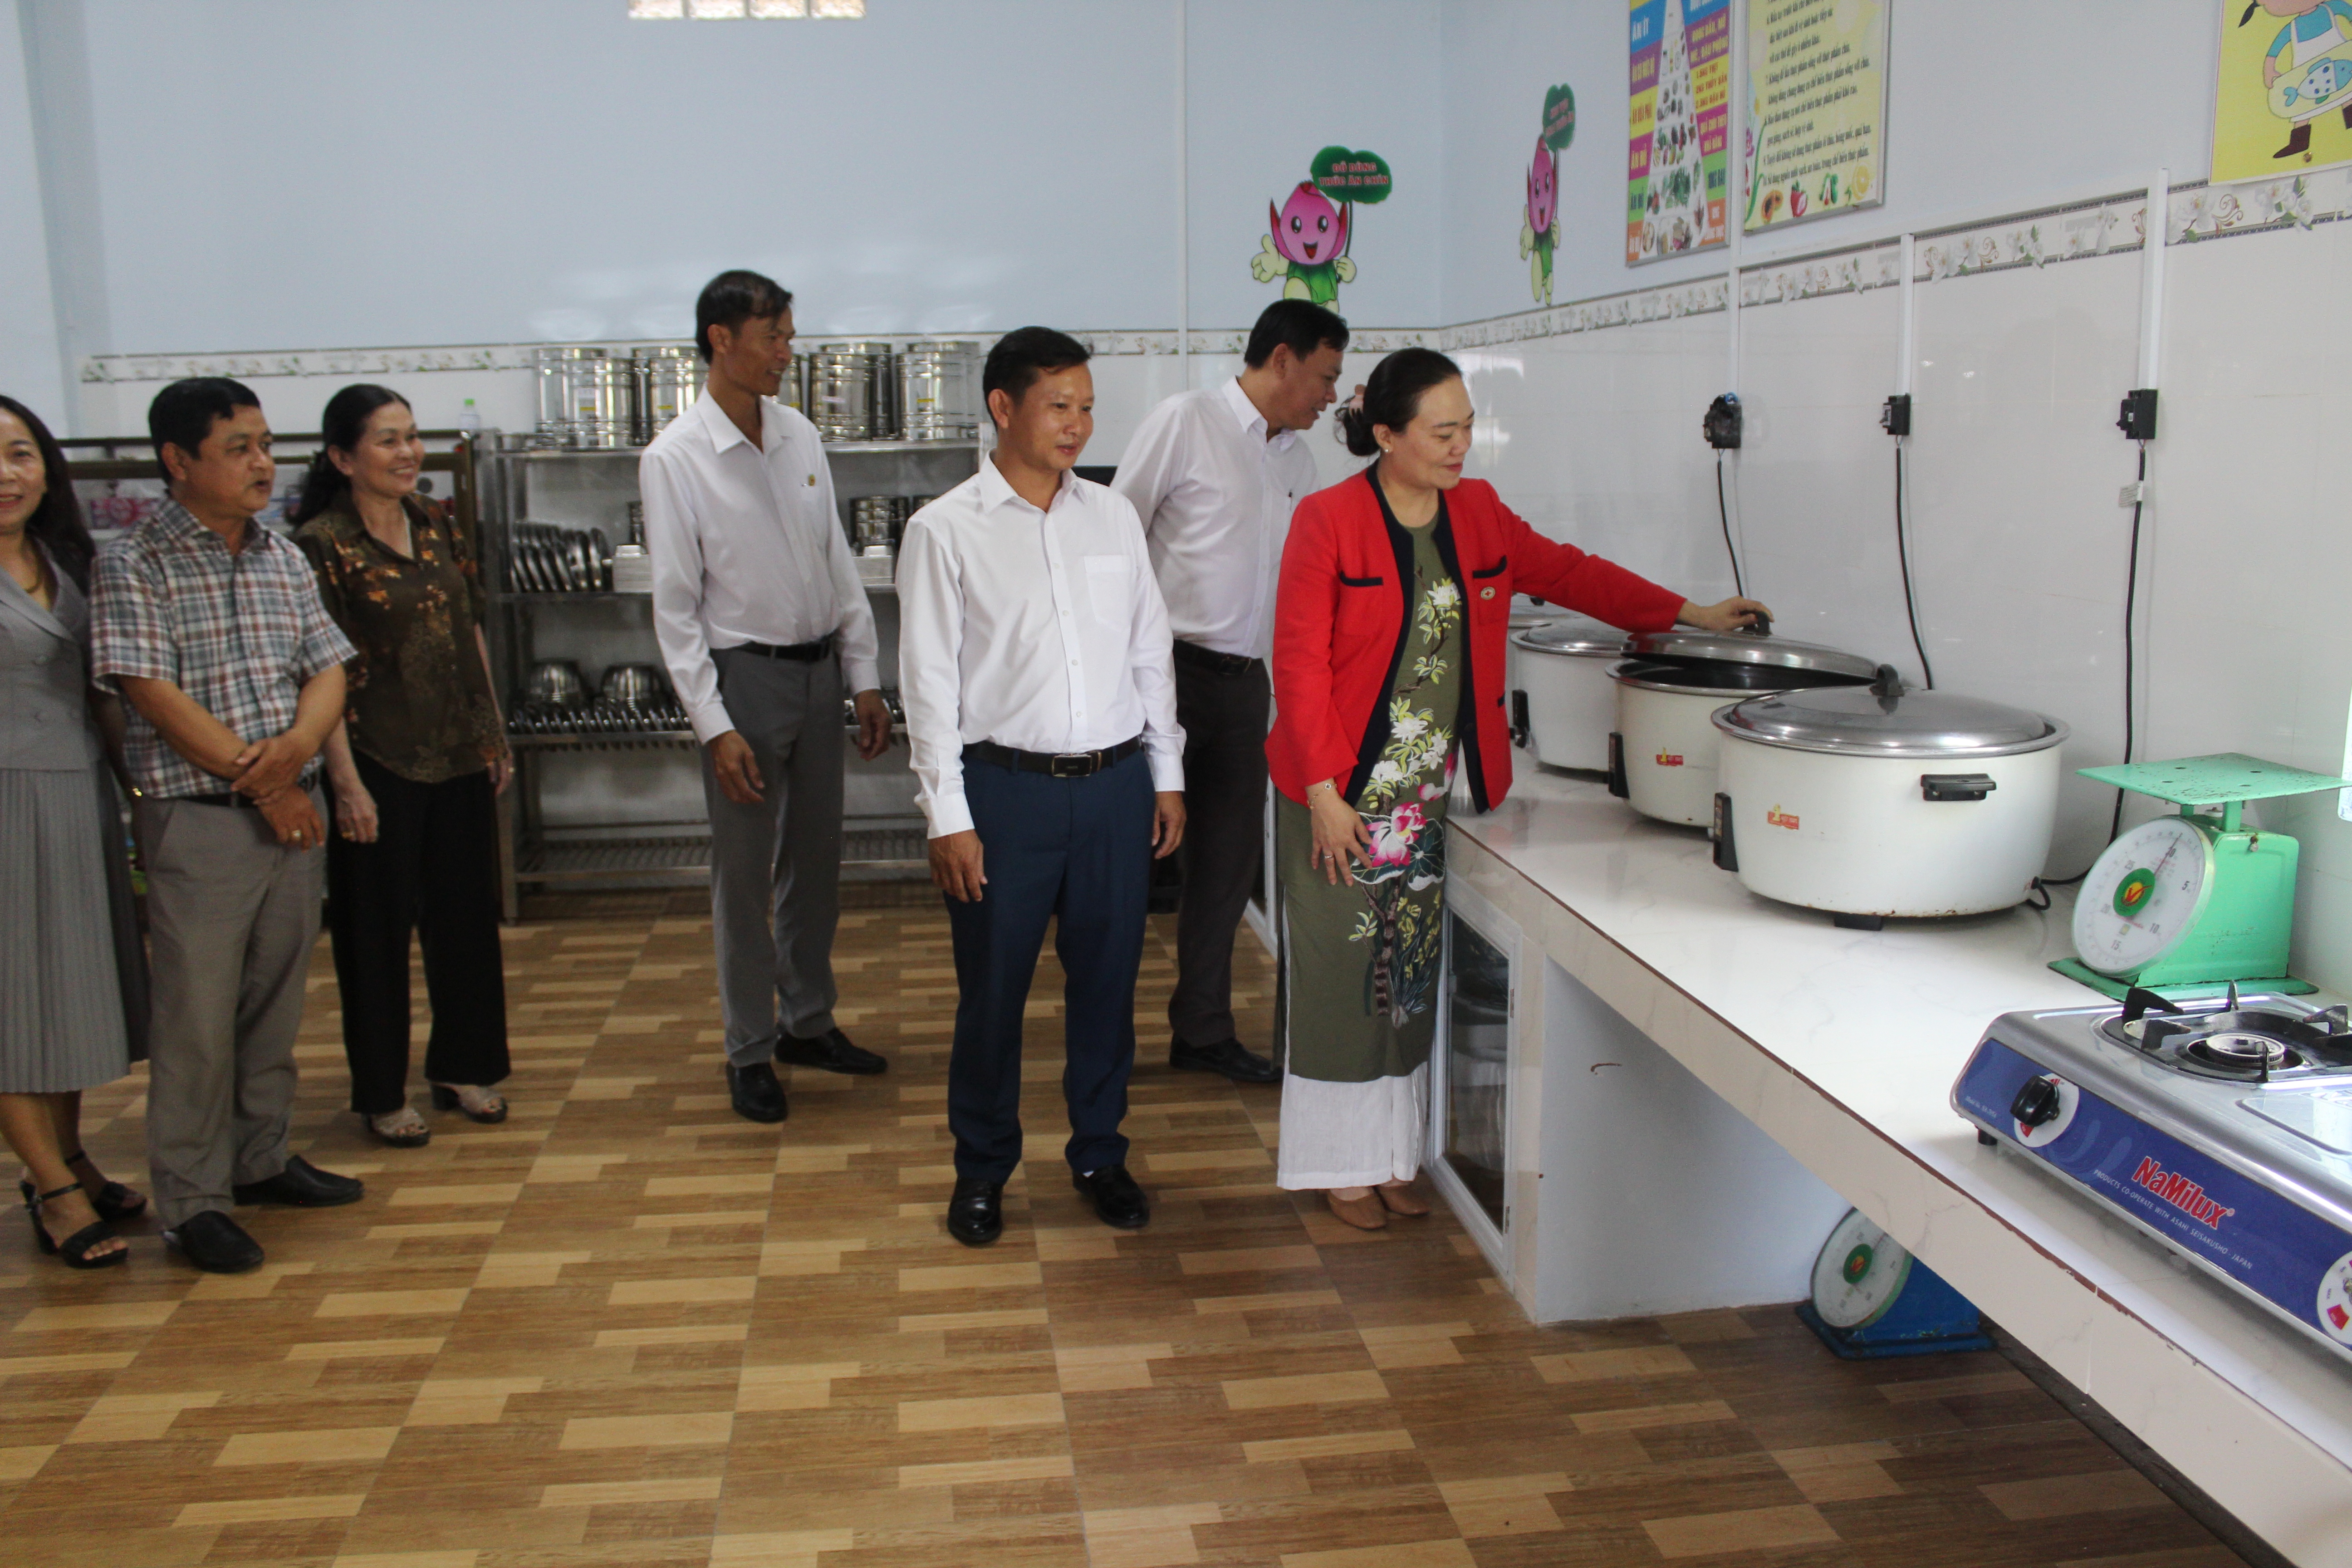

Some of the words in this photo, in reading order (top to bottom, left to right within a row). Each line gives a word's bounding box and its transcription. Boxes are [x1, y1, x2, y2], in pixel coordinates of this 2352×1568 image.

[1319, 174, 1346, 186] THỨC
[1348, 174, 1362, 185] ĂN
[1364, 173, 1388, 185] CHÍN
[2181, 880, 2190, 890] 5
[2149, 922, 2160, 934] 10
[2132, 1156, 2228, 1230] NaMilux
[2093, 1169, 2121, 1189] PRODUCTS
[2122, 1186, 2154, 1210] CO-OPERATE
[2155, 1206, 2170, 1220] WITH
[2171, 1216, 2189, 1231] ASAHI
[2190, 1228, 2228, 1255] SEISAKUSHO
[2231, 1254, 2254, 1270] JAPAN
